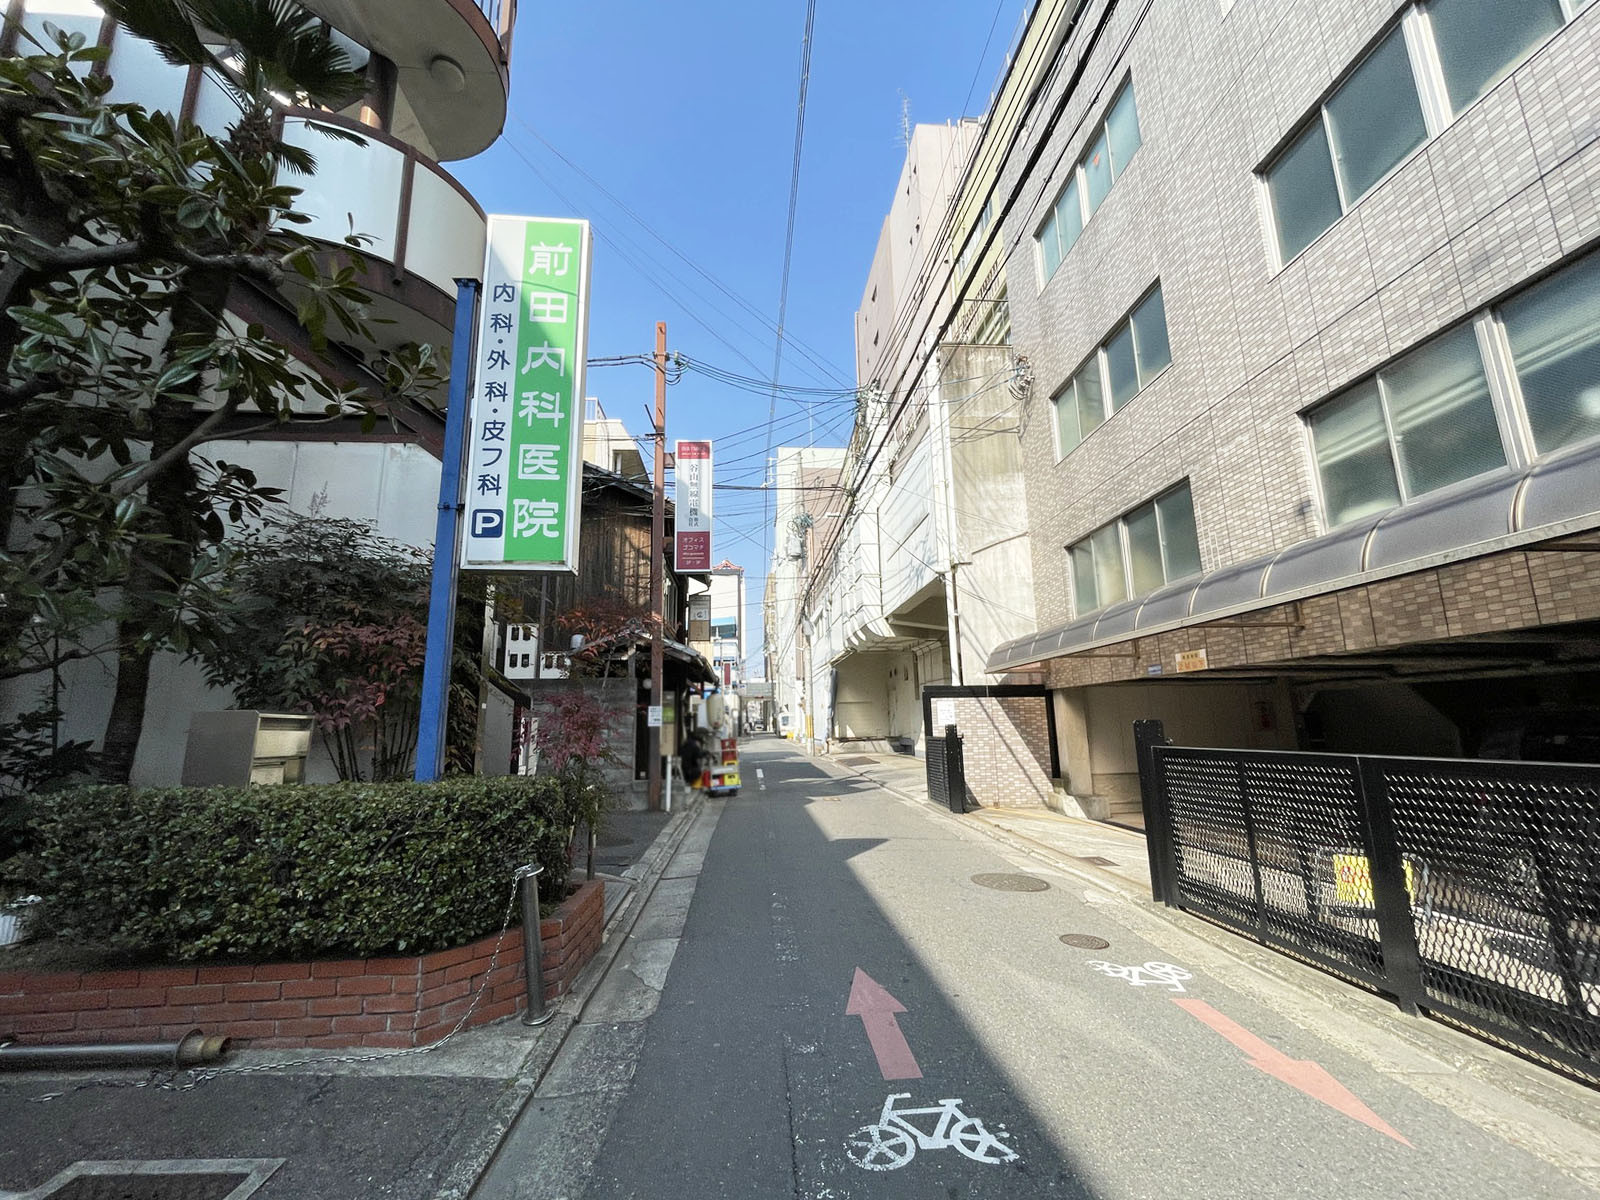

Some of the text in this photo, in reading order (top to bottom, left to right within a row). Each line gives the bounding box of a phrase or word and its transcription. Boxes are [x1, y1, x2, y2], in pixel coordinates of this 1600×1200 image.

[512, 241, 573, 538] 前田内科医院
